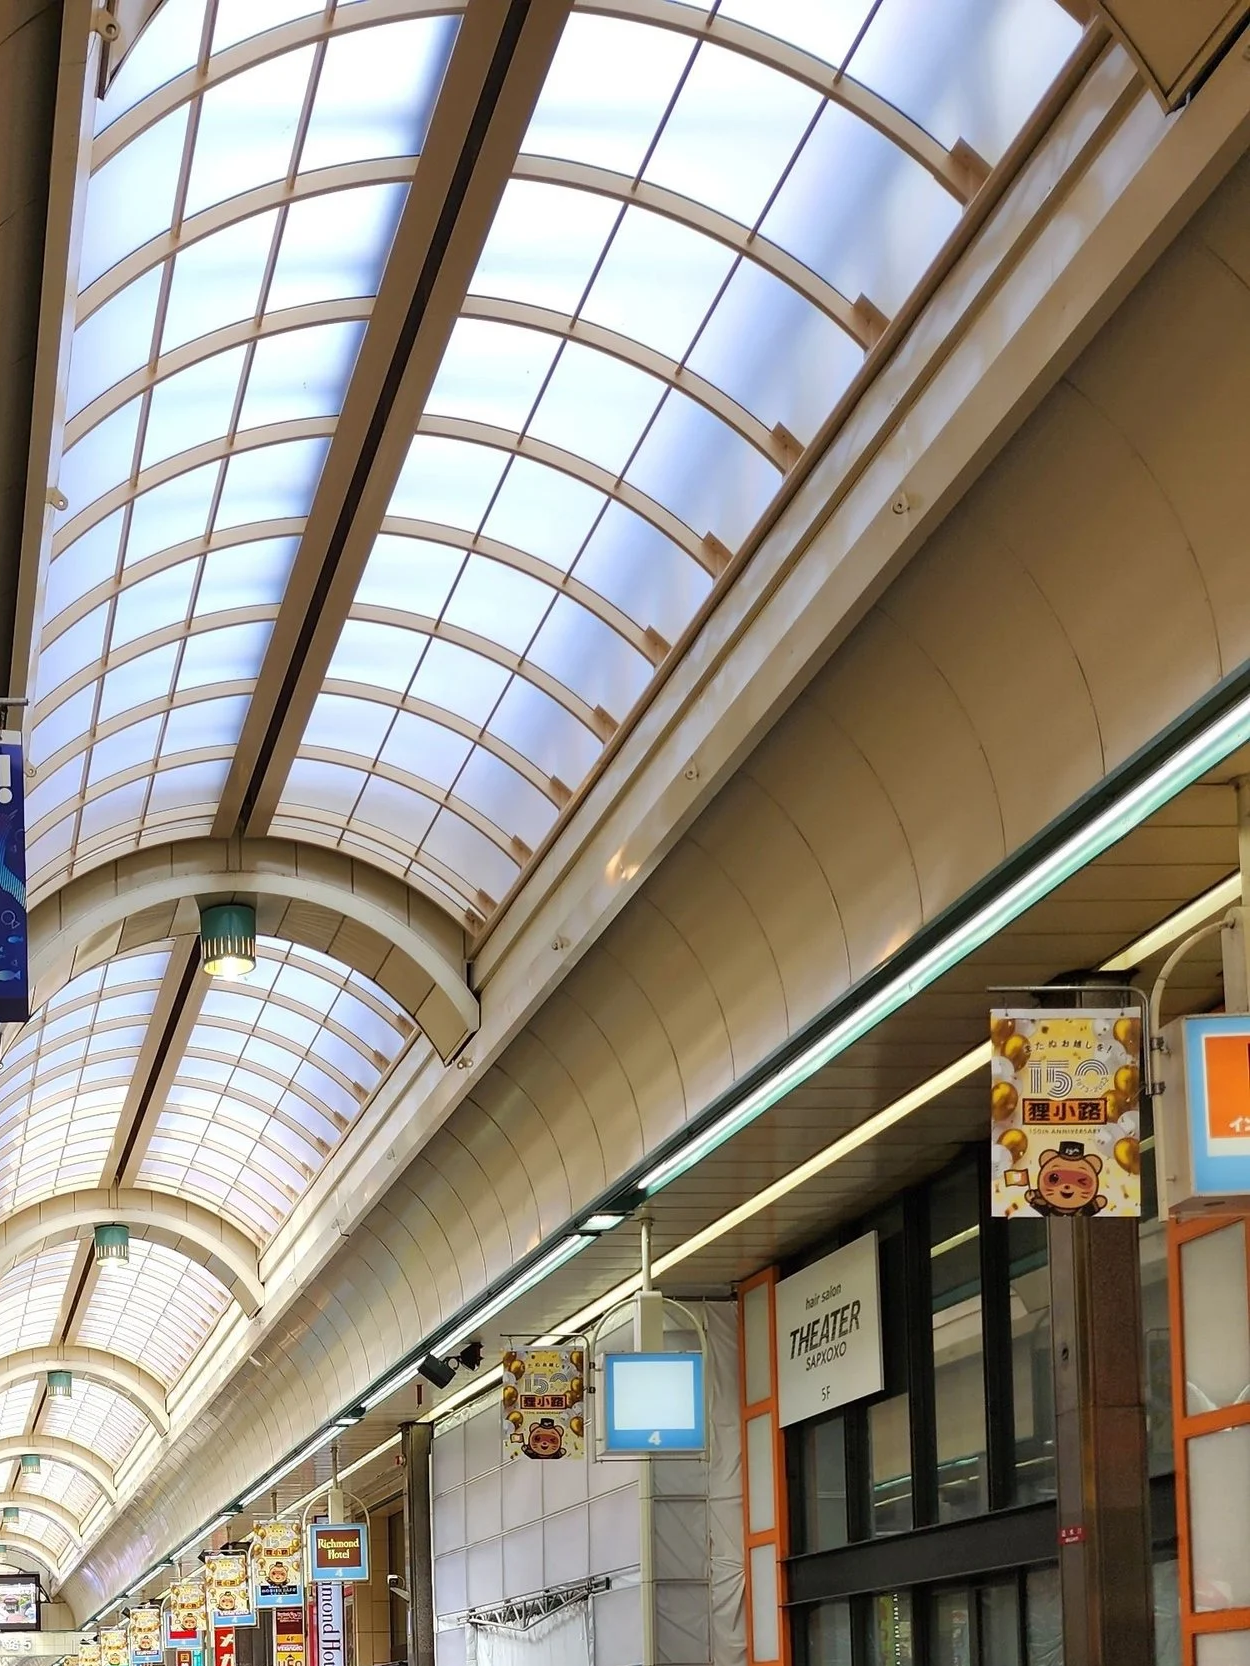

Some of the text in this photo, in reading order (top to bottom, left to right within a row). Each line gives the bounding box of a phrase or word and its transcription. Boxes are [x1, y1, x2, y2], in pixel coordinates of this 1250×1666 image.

[1027, 1058, 1109, 1098] 150
[1028, 1102, 1103, 1122] 狸小路
[805, 1283, 842, 1310] hair salon
[790, 1299, 861, 1360] THEATER
[806, 1341, 847, 1371] SAPXOXO
[821, 1385, 831, 1401] 5F
[648, 1431, 662, 1446] 4
[318, 1538, 360, 1549] Richmond
[327, 1549, 350, 1559] Hotel
[335, 1568, 344, 1577] 4
